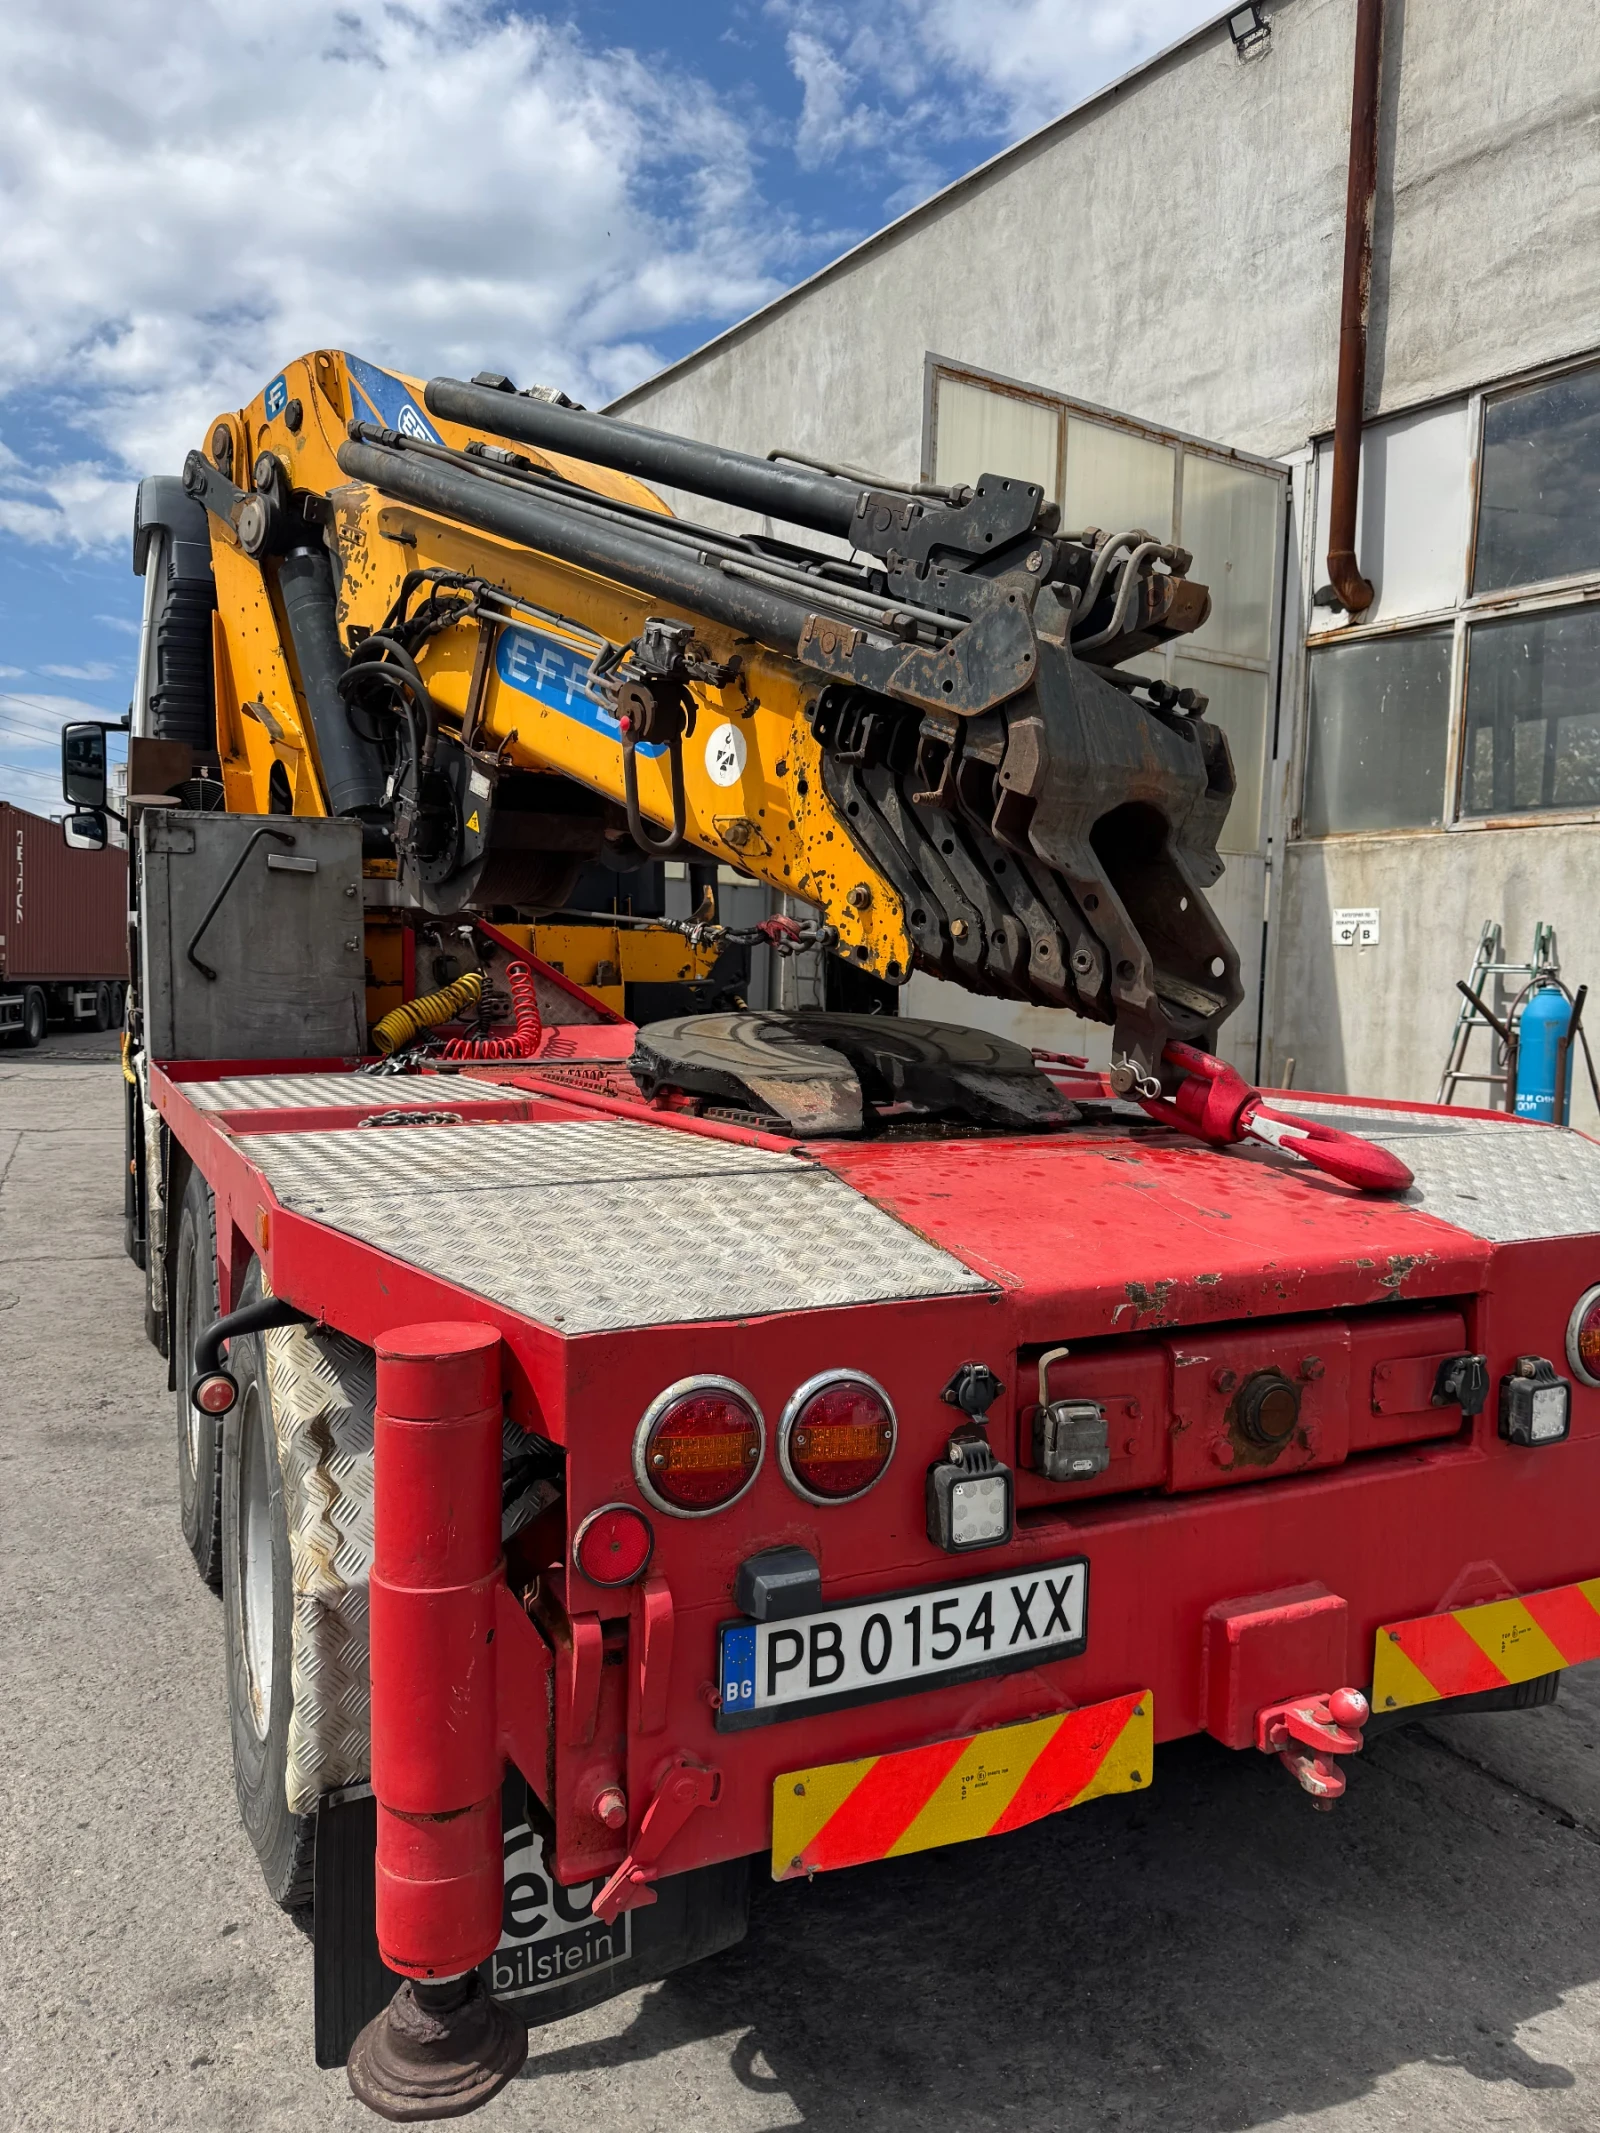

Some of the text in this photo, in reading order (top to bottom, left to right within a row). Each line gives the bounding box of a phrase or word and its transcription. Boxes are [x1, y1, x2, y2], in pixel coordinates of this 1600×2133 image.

[766, 1574, 1074, 1697] PB 0154 XX
[725, 1680, 752, 1702] BG
[961, 1775, 974, 1783] TOP
[492, 1930, 613, 1990] bilstein
